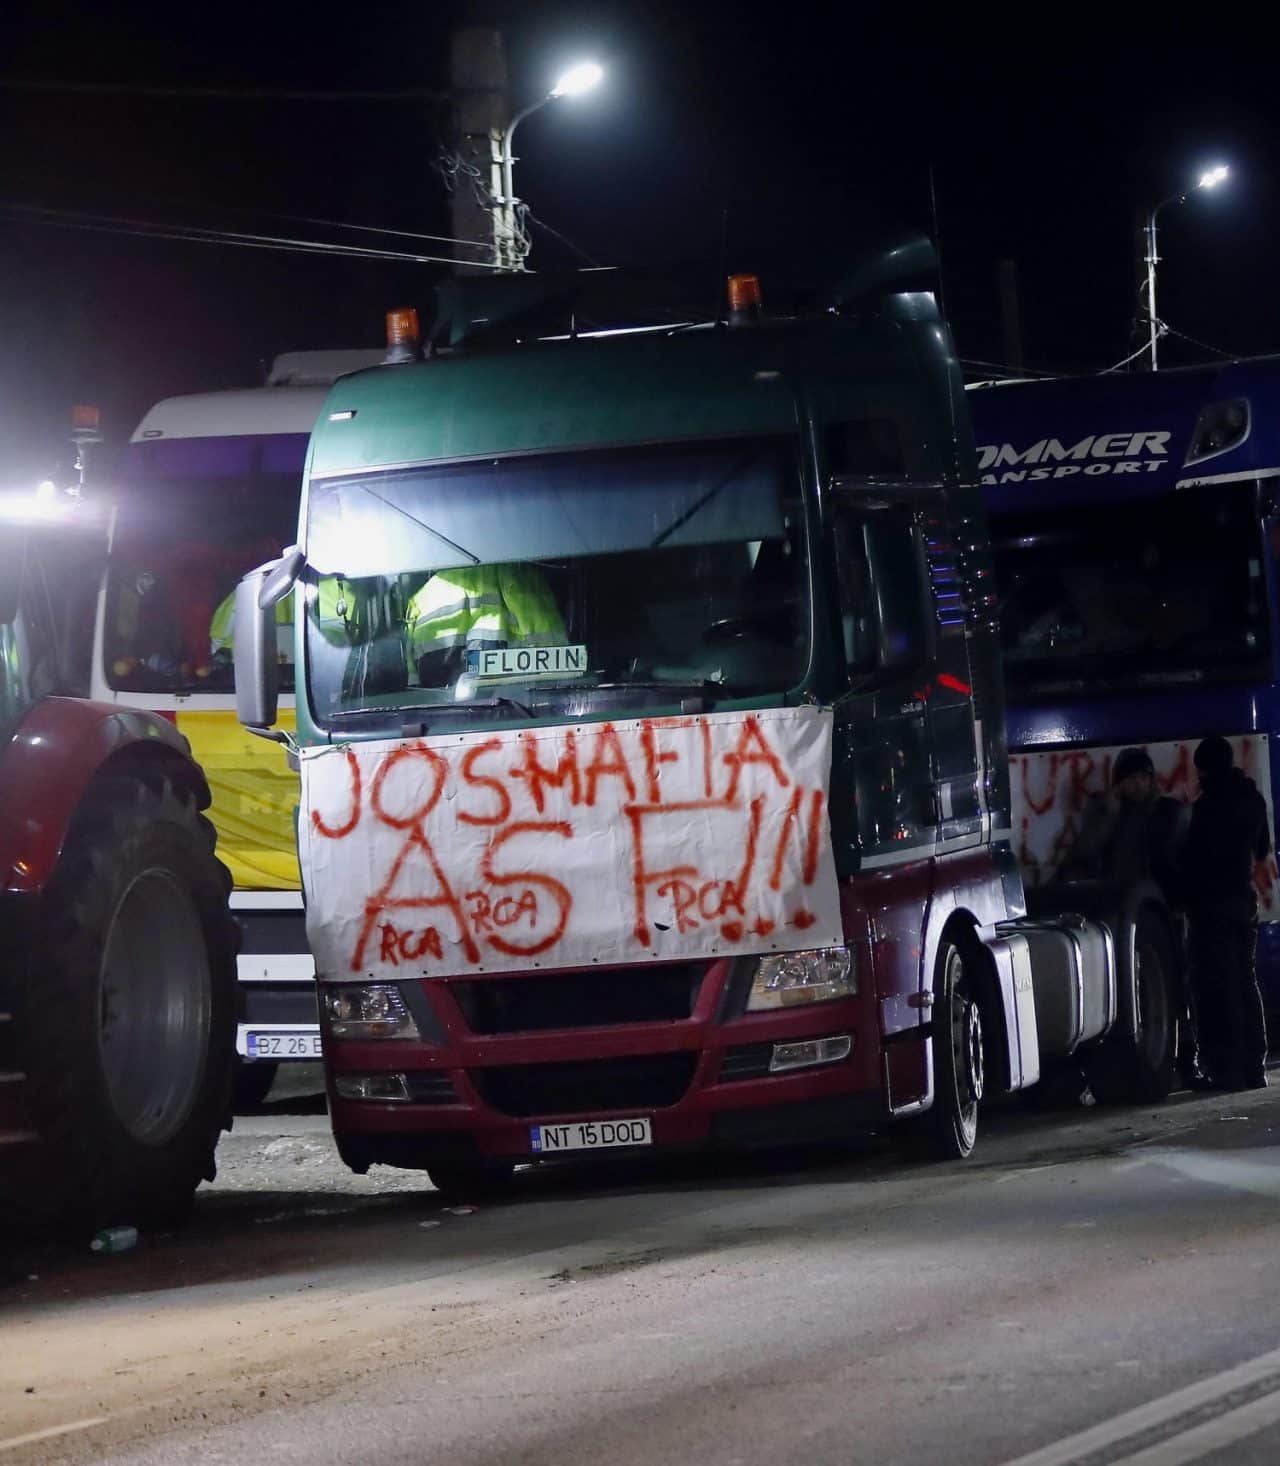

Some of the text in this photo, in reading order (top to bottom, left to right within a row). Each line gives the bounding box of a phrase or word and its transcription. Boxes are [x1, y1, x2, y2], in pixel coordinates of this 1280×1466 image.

[976, 431, 1172, 469] OMMER
[981, 460, 1168, 485] ANSPORT
[484, 648, 579, 673] FLORIN
[312, 715, 789, 839] JOS MAFIA
[379, 880, 747, 964] RCA RCA RCA
[259, 1038, 281, 1054] BZ
[288, 1038, 307, 1054] 26
[544, 1127, 570, 1148] NT
[578, 1124, 597, 1145] 15
[601, 1121, 646, 1143] DOD
